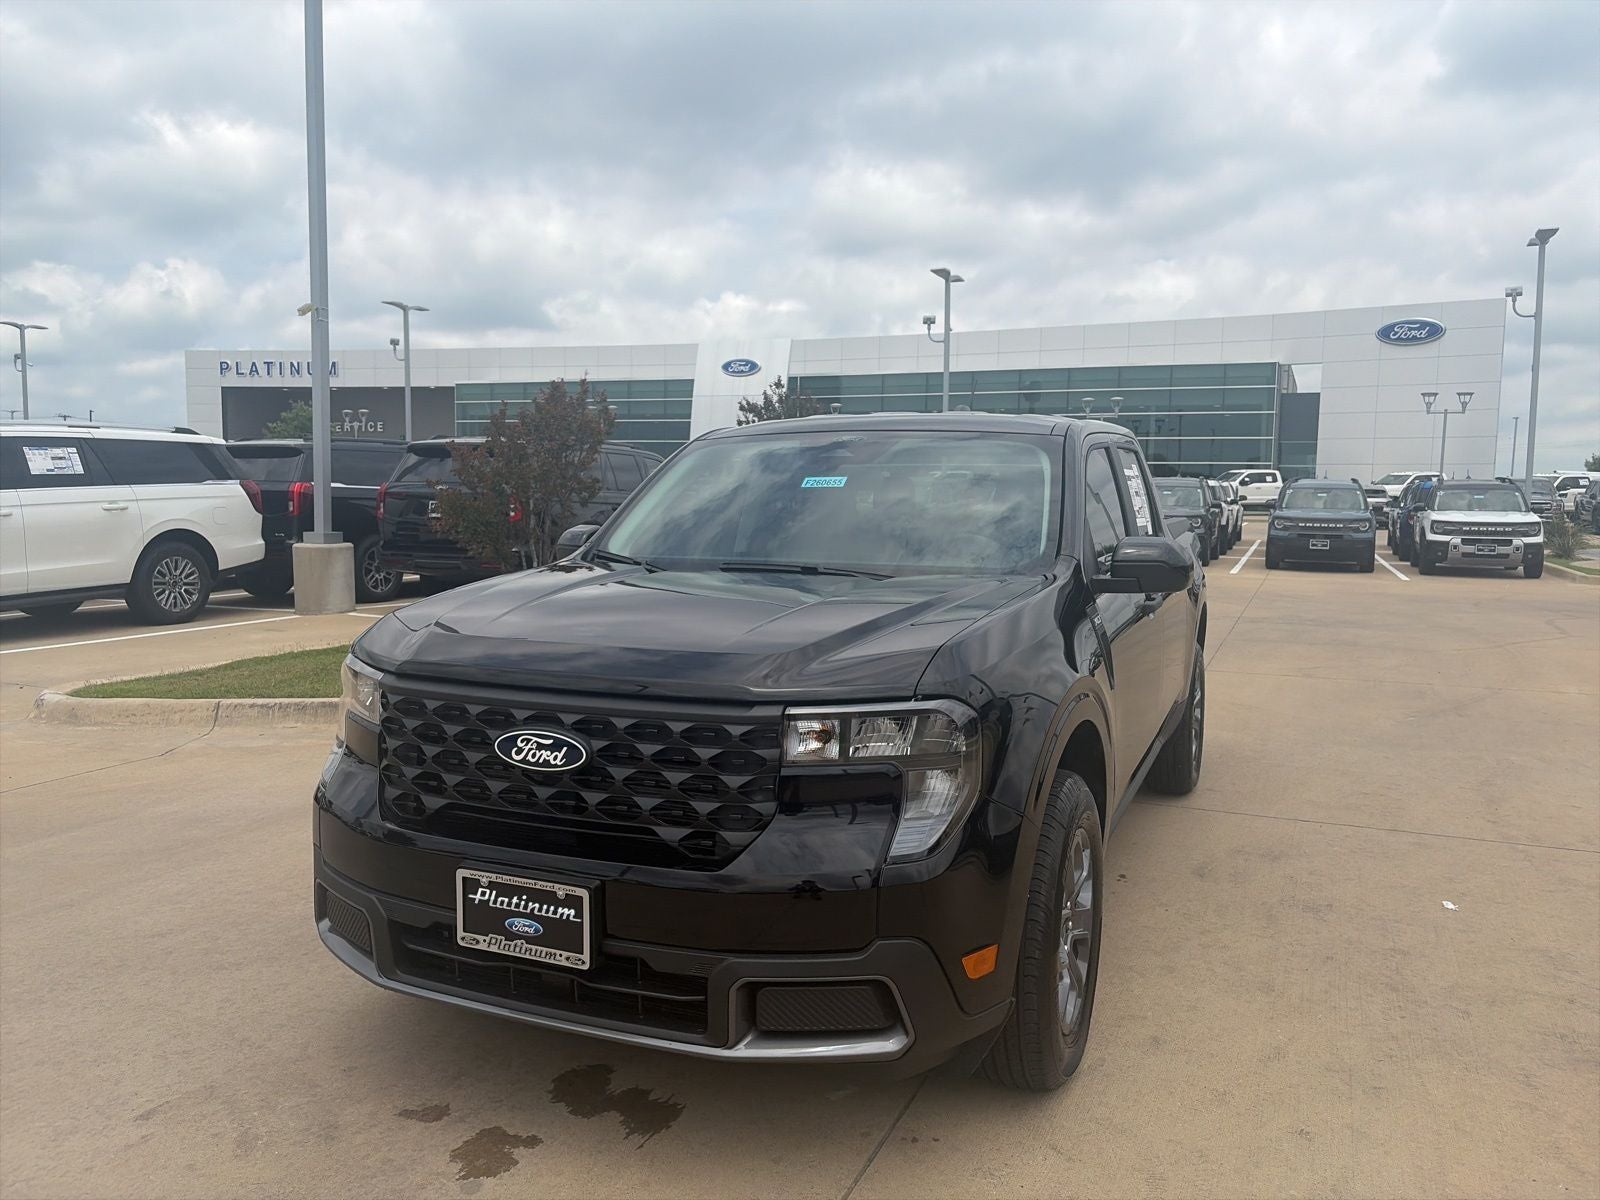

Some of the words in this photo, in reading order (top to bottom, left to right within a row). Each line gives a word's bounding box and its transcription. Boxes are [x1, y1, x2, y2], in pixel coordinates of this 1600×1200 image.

[1390, 324, 1430, 339] Ford
[728, 361, 751, 372] Ford
[511, 735, 568, 766] Ford
[468, 871, 577, 894] www.PlatinumFord.com
[468, 887, 582, 922] Platinum
[512, 919, 535, 934] Ford
[487, 935, 563, 962] Platinum
